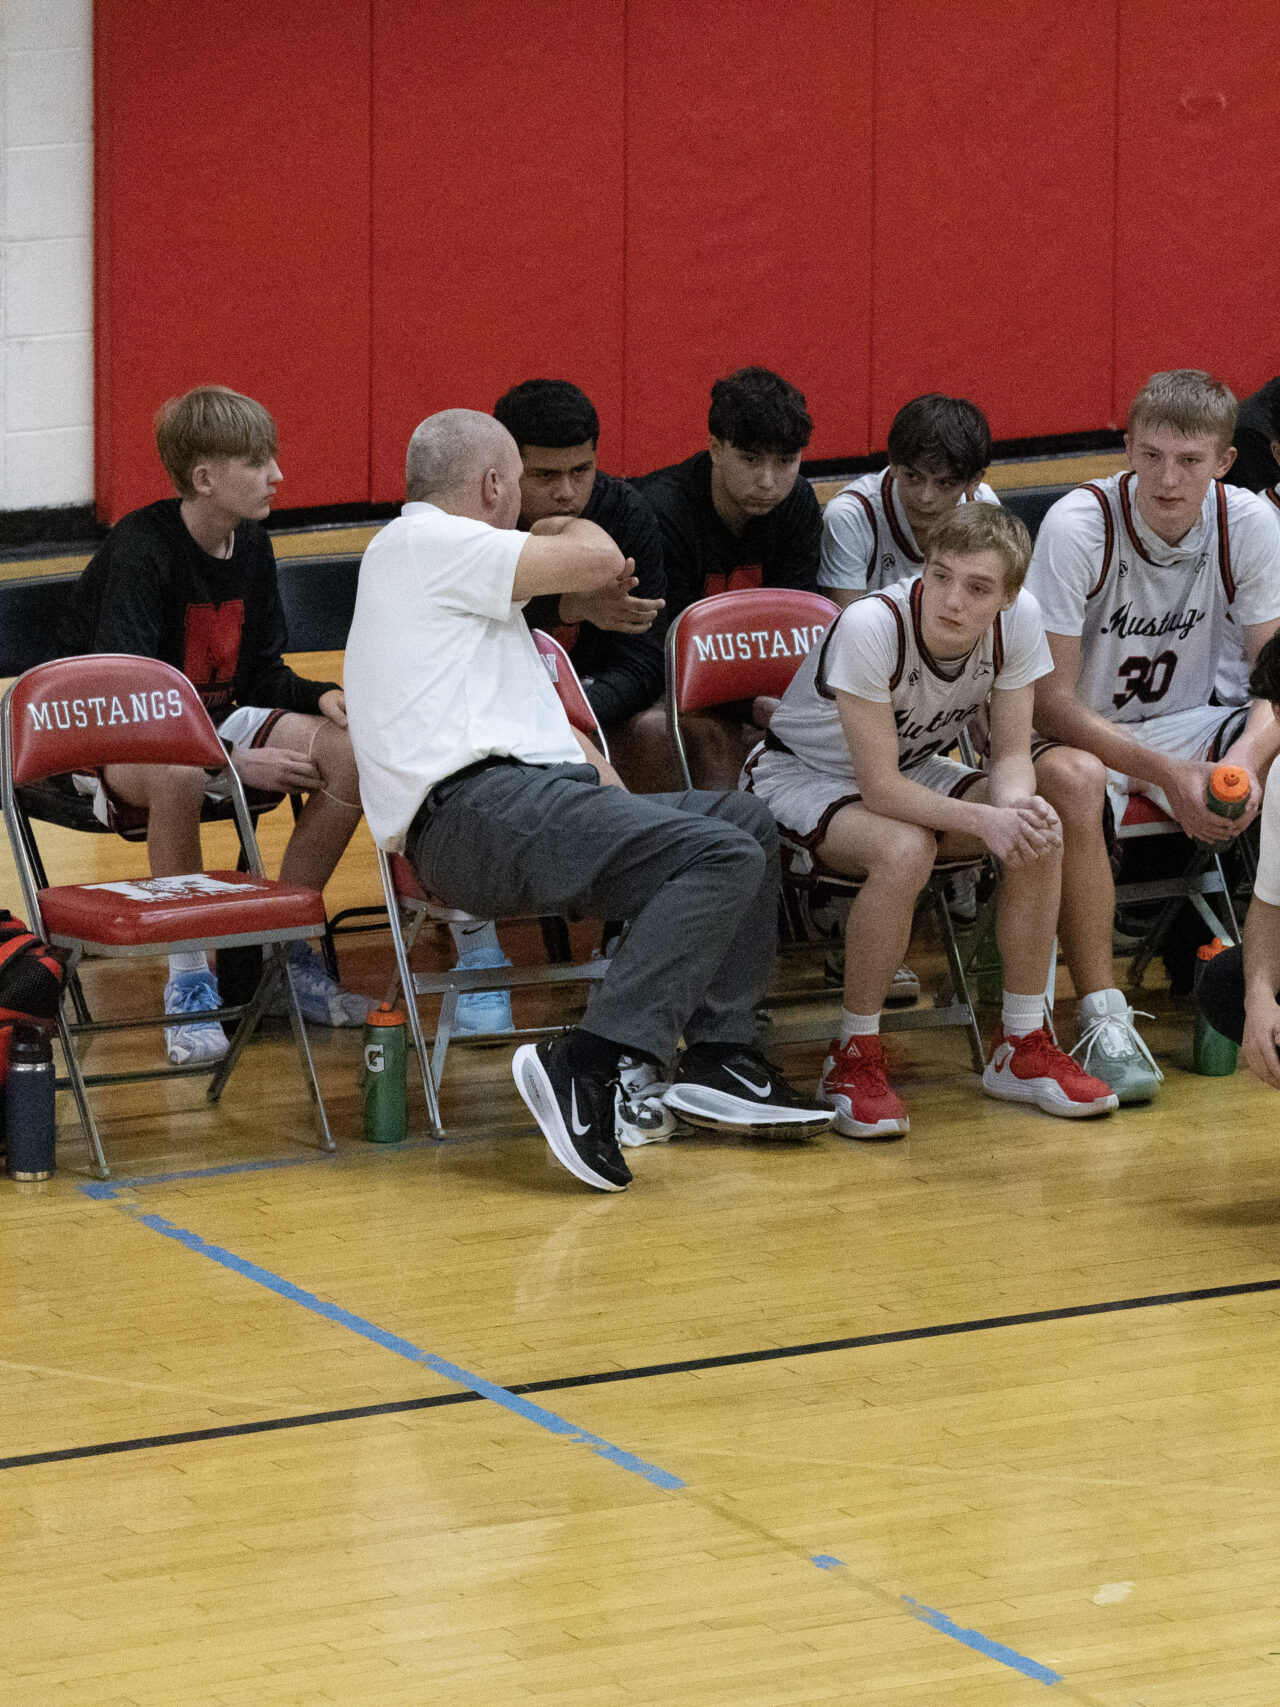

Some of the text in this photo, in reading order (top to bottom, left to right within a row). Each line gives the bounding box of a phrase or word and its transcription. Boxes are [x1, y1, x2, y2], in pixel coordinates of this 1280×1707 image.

[184, 599, 245, 684] M
[1112, 650, 1178, 710] 30
[27, 688, 183, 731] MUSTANGS
[364, 1043, 385, 1073] G
